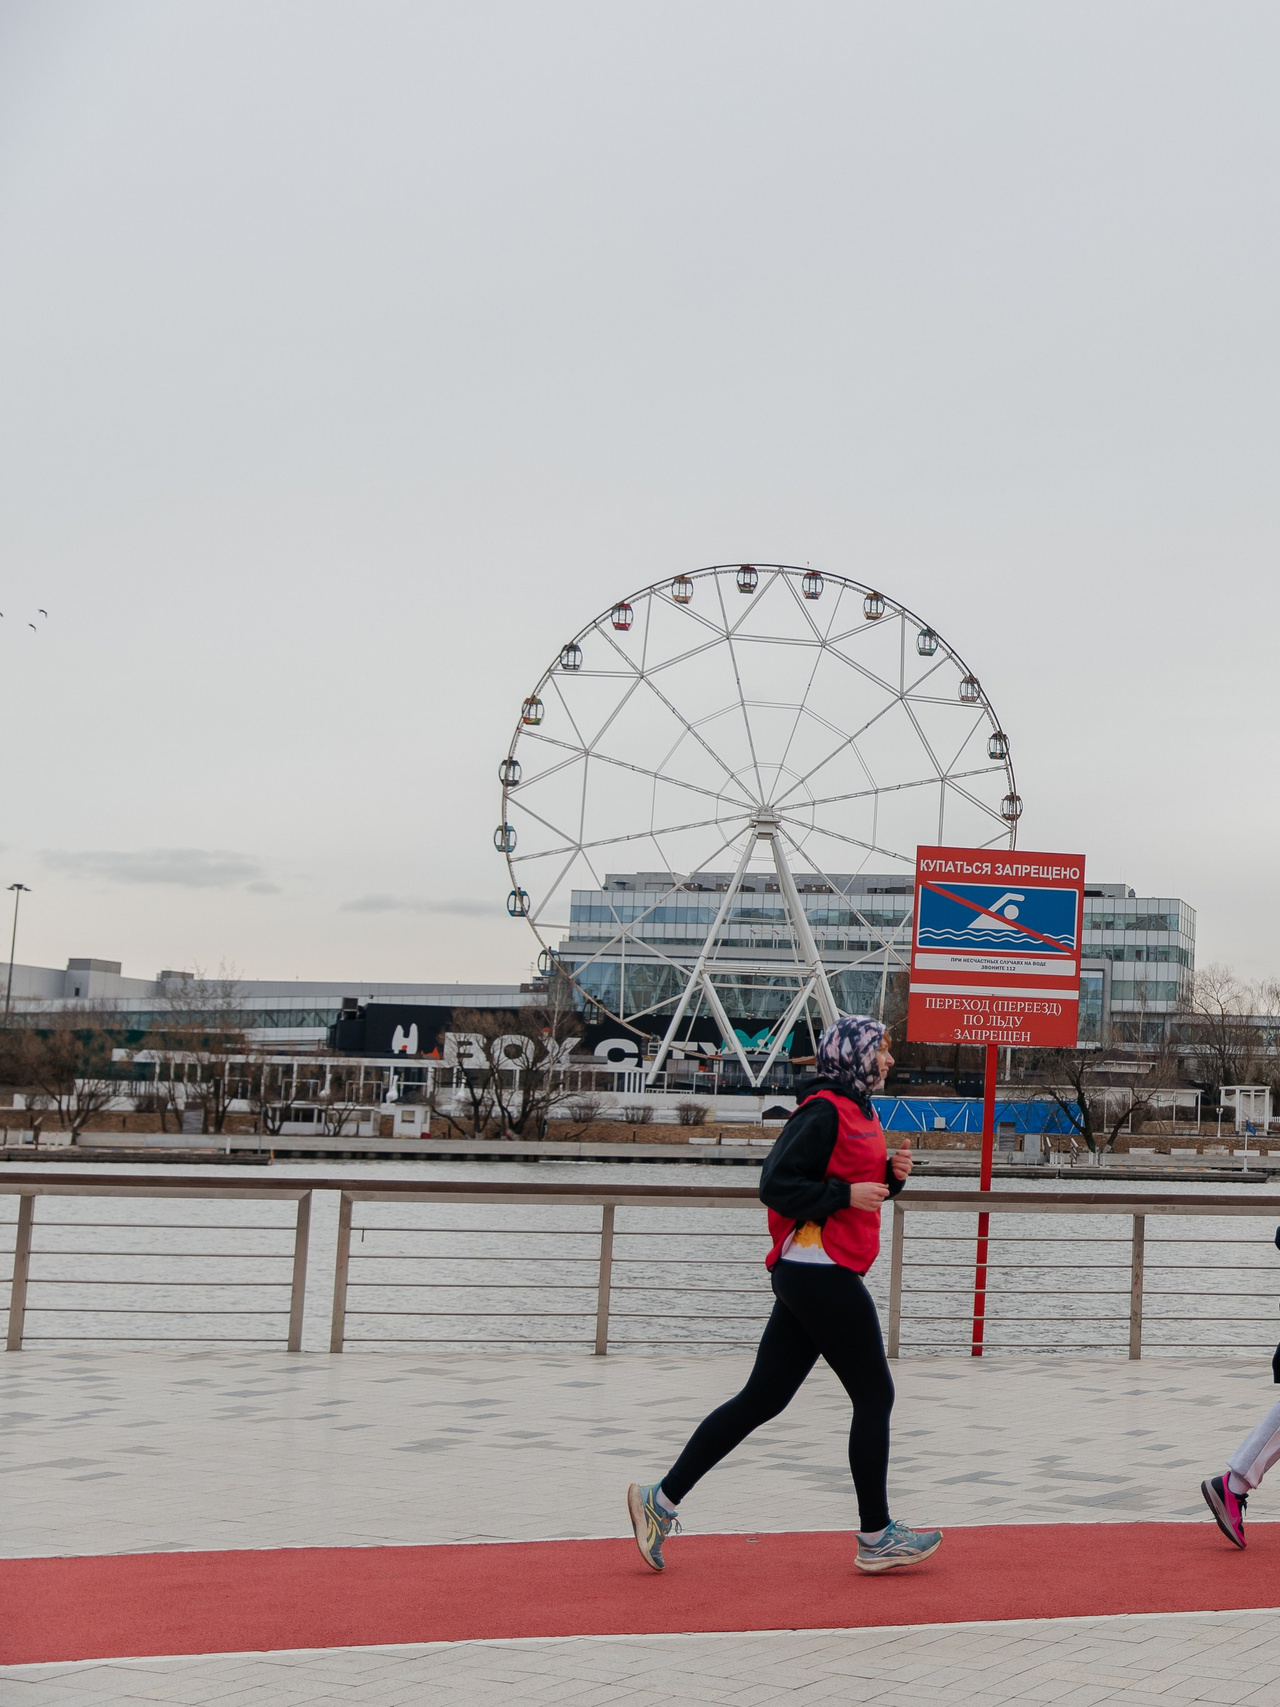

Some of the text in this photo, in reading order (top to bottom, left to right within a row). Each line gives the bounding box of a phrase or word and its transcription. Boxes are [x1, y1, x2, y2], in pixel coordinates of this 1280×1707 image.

[919, 859, 1080, 881] КУПАТЬСЯ ЗАПРЕЩЕНО
[925, 997, 1062, 1016] ПЕРЕХОД (ПЕРЕЕЗД)
[963, 1014, 1023, 1028] ПО ЛЬДУ
[954, 1028, 1031, 1042] ЗАПРЕЩЕН
[444, 1032, 729, 1069] BOX CTY
